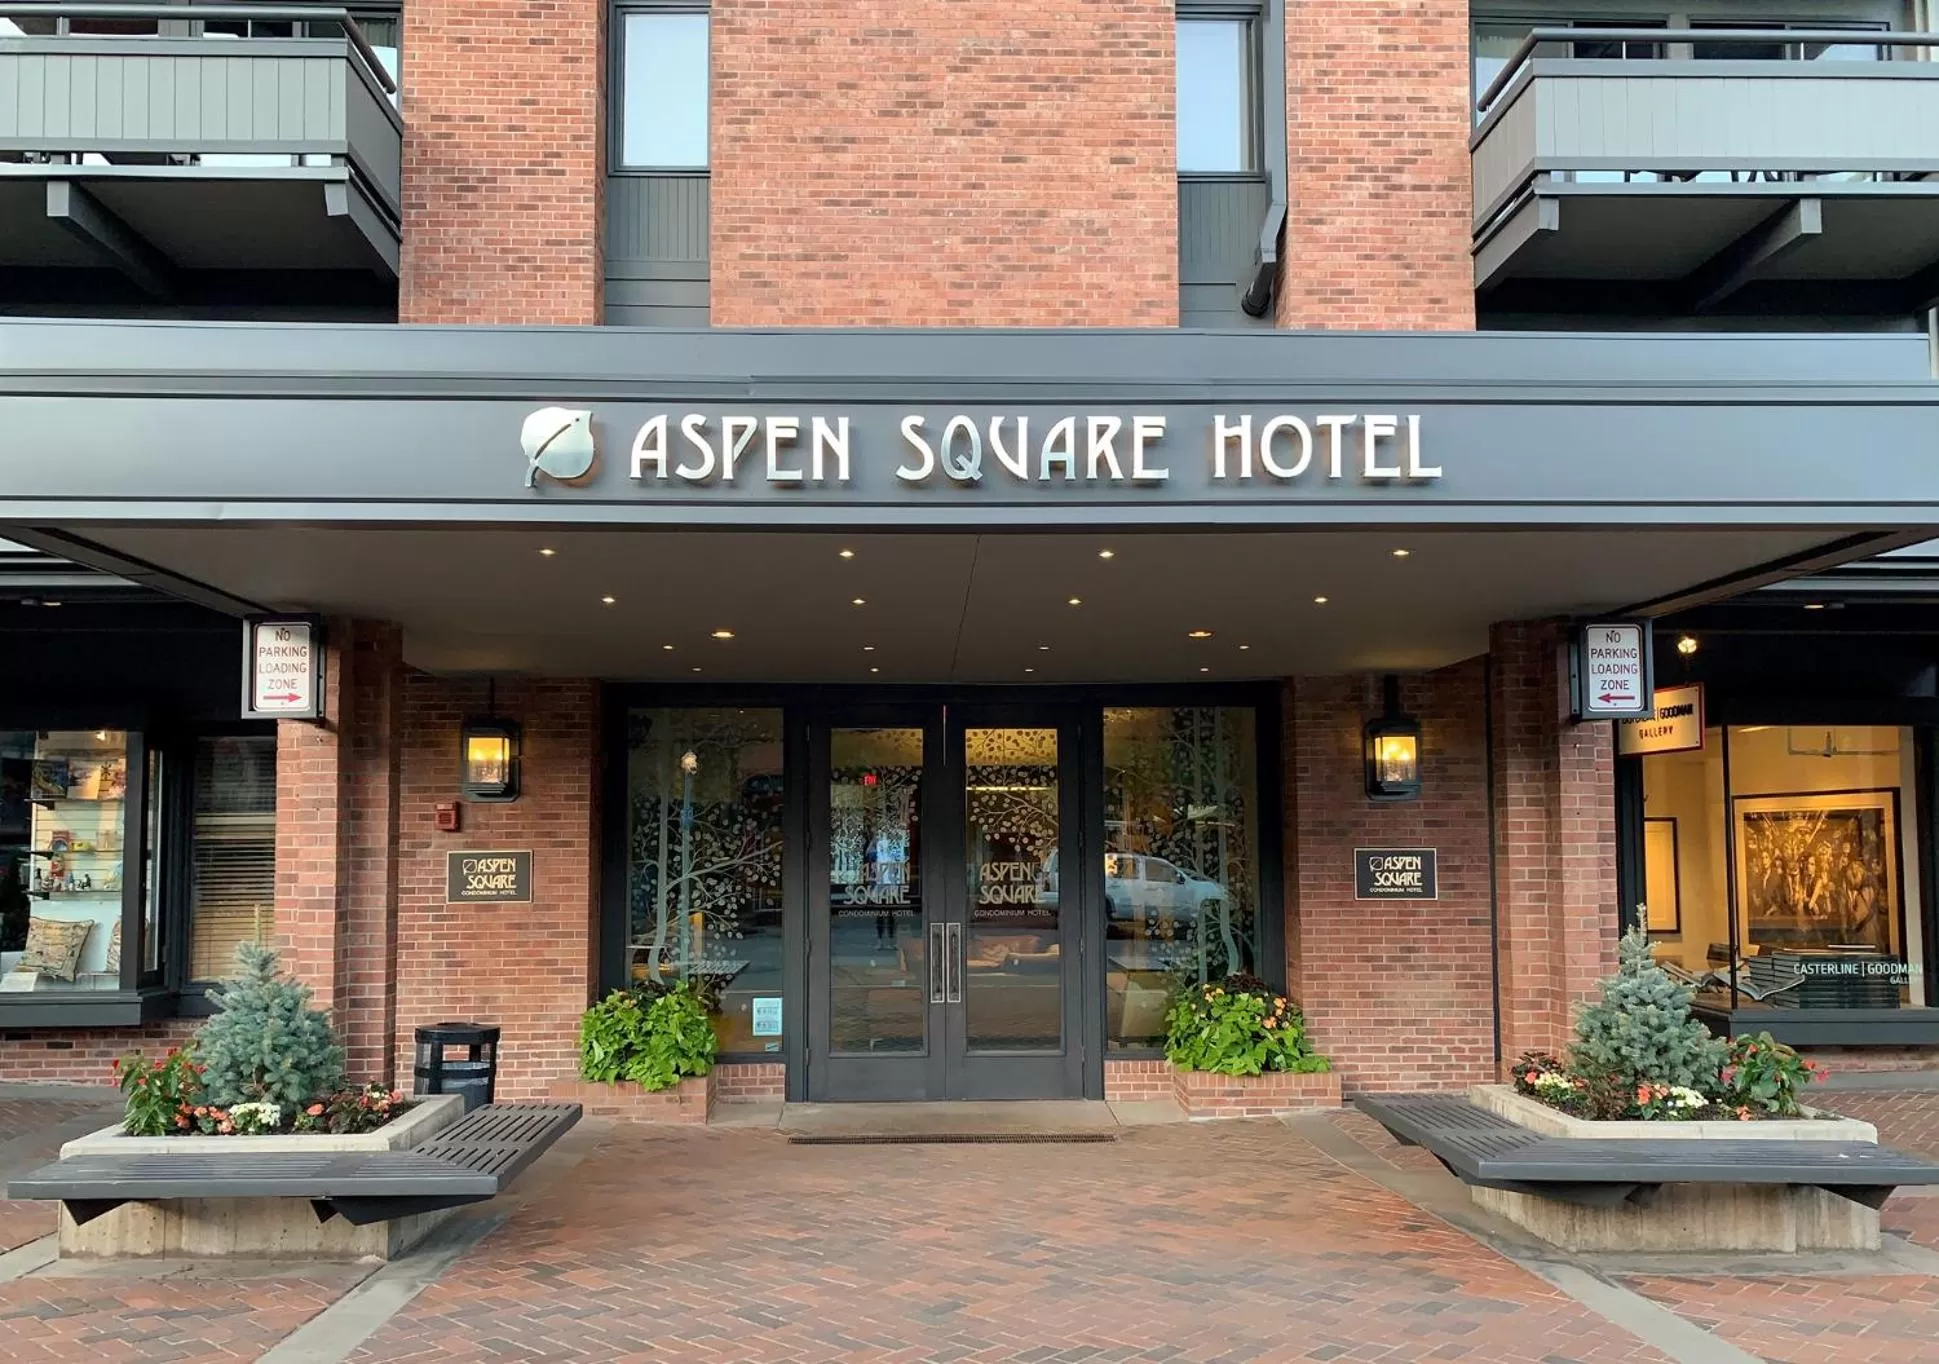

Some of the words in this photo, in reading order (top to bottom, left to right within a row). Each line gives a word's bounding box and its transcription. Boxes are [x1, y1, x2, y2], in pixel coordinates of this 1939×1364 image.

[629, 413, 850, 481] ASPEN
[896, 414, 1169, 482] SQUARE
[1213, 413, 1443, 479] HOTEL
[275, 630, 291, 641] NO
[1606, 632, 1621, 643] NO
[259, 646, 308, 657] PARKING
[1590, 648, 1638, 659] PARKING
[259, 662, 308, 674] LOADING
[1591, 664, 1638, 675] LOADING
[267, 678, 298, 689] ZONE
[1600, 679, 1630, 690] ZONE
[1639, 725, 1674, 740] GALLERY
[477, 858, 517, 873] ASPEN
[1383, 856, 1422, 870] ASPEN
[979, 862, 1032, 881] ASPEN
[466, 874, 518, 889] SQUARE
[1373, 872, 1423, 887] SQUARE
[843, 885, 911, 905] SQUARE
[979, 885, 1048, 905] SQUARE
[891, 909, 914, 917] HOTEL
[1027, 909, 1052, 917] HOTEL
[1793, 962, 1860, 975] CASTERLINE
[1867, 962, 1922, 975] GOODMAN
